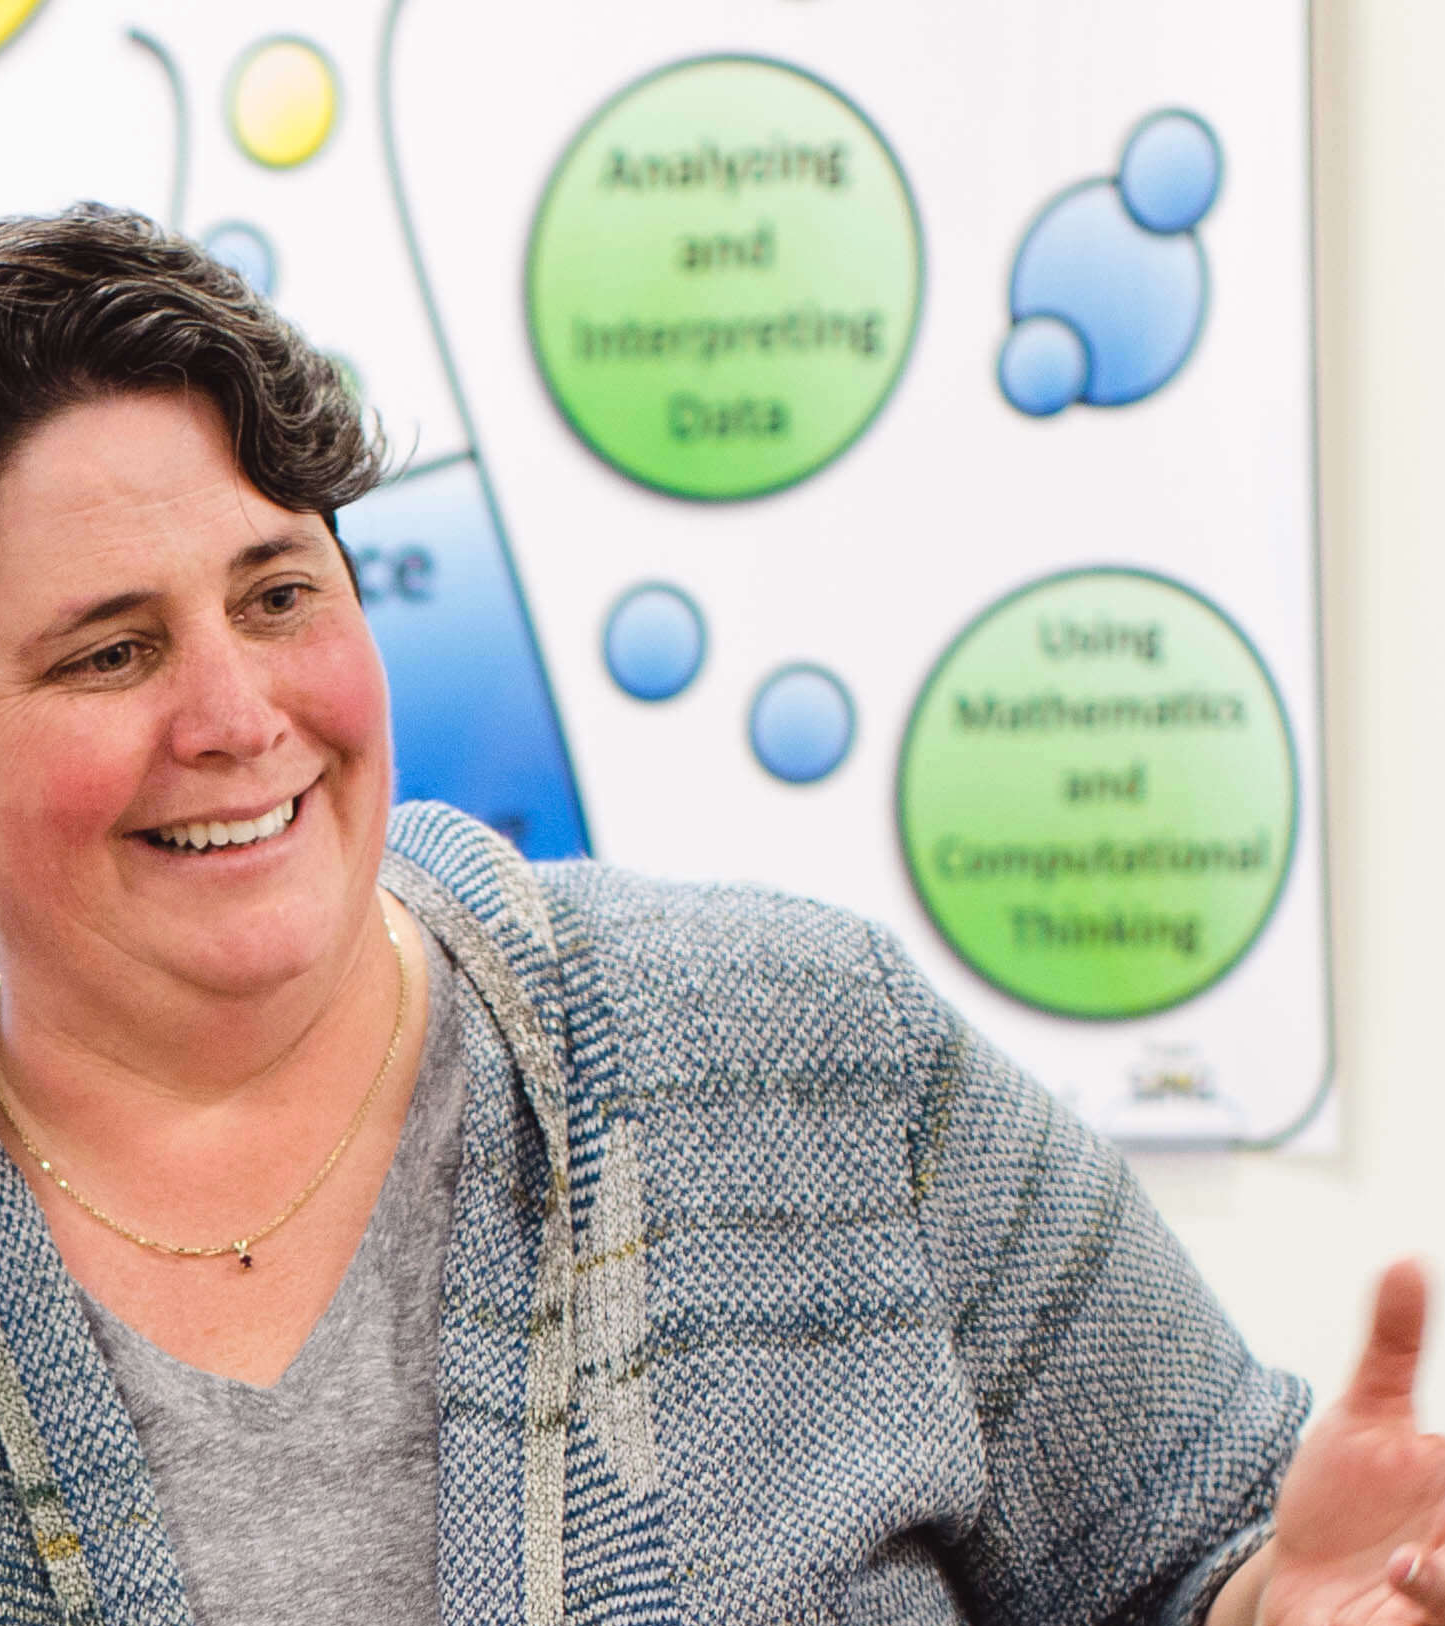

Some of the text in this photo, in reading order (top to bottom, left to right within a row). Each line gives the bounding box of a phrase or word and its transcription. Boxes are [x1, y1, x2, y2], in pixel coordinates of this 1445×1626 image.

[605, 143, 849, 198] Analyzing
[680, 224, 773, 273] and
[574, 312, 882, 366] Interpreting
[668, 392, 791, 442] Data
[1040, 610, 1164, 666] Using
[954, 689, 1246, 734] Mathematics
[1063, 760, 1145, 806] and
[936, 828, 1270, 884] Computational
[1012, 902, 1198, 958] Thinking
